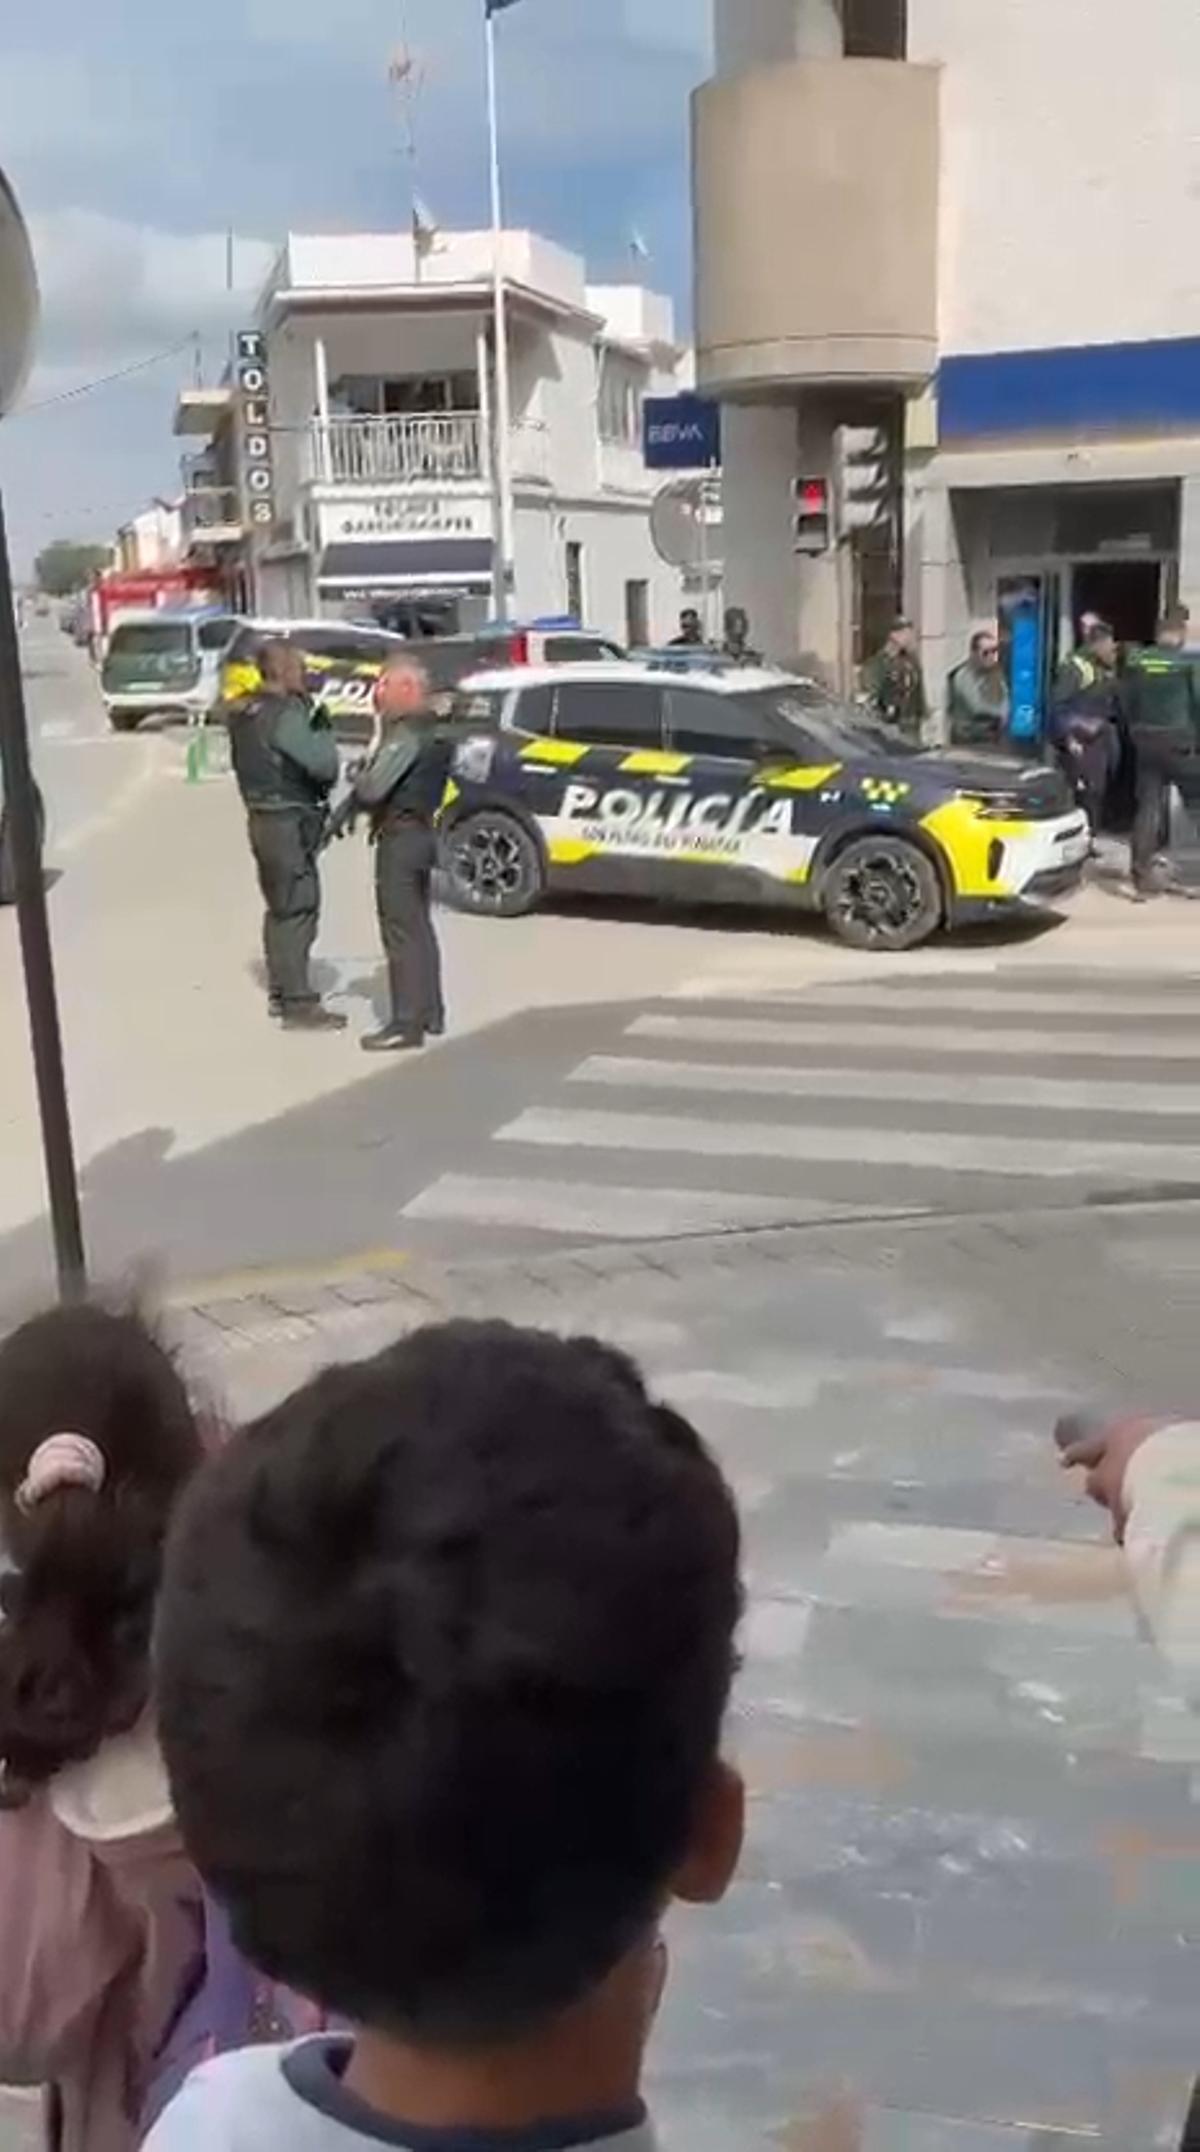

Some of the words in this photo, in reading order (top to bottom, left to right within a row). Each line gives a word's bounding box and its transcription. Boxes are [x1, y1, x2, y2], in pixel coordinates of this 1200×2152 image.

[239, 333, 273, 523] TOLDOS
[648, 422, 704, 445] BBVA
[557, 783, 794, 835] POLICÍA
